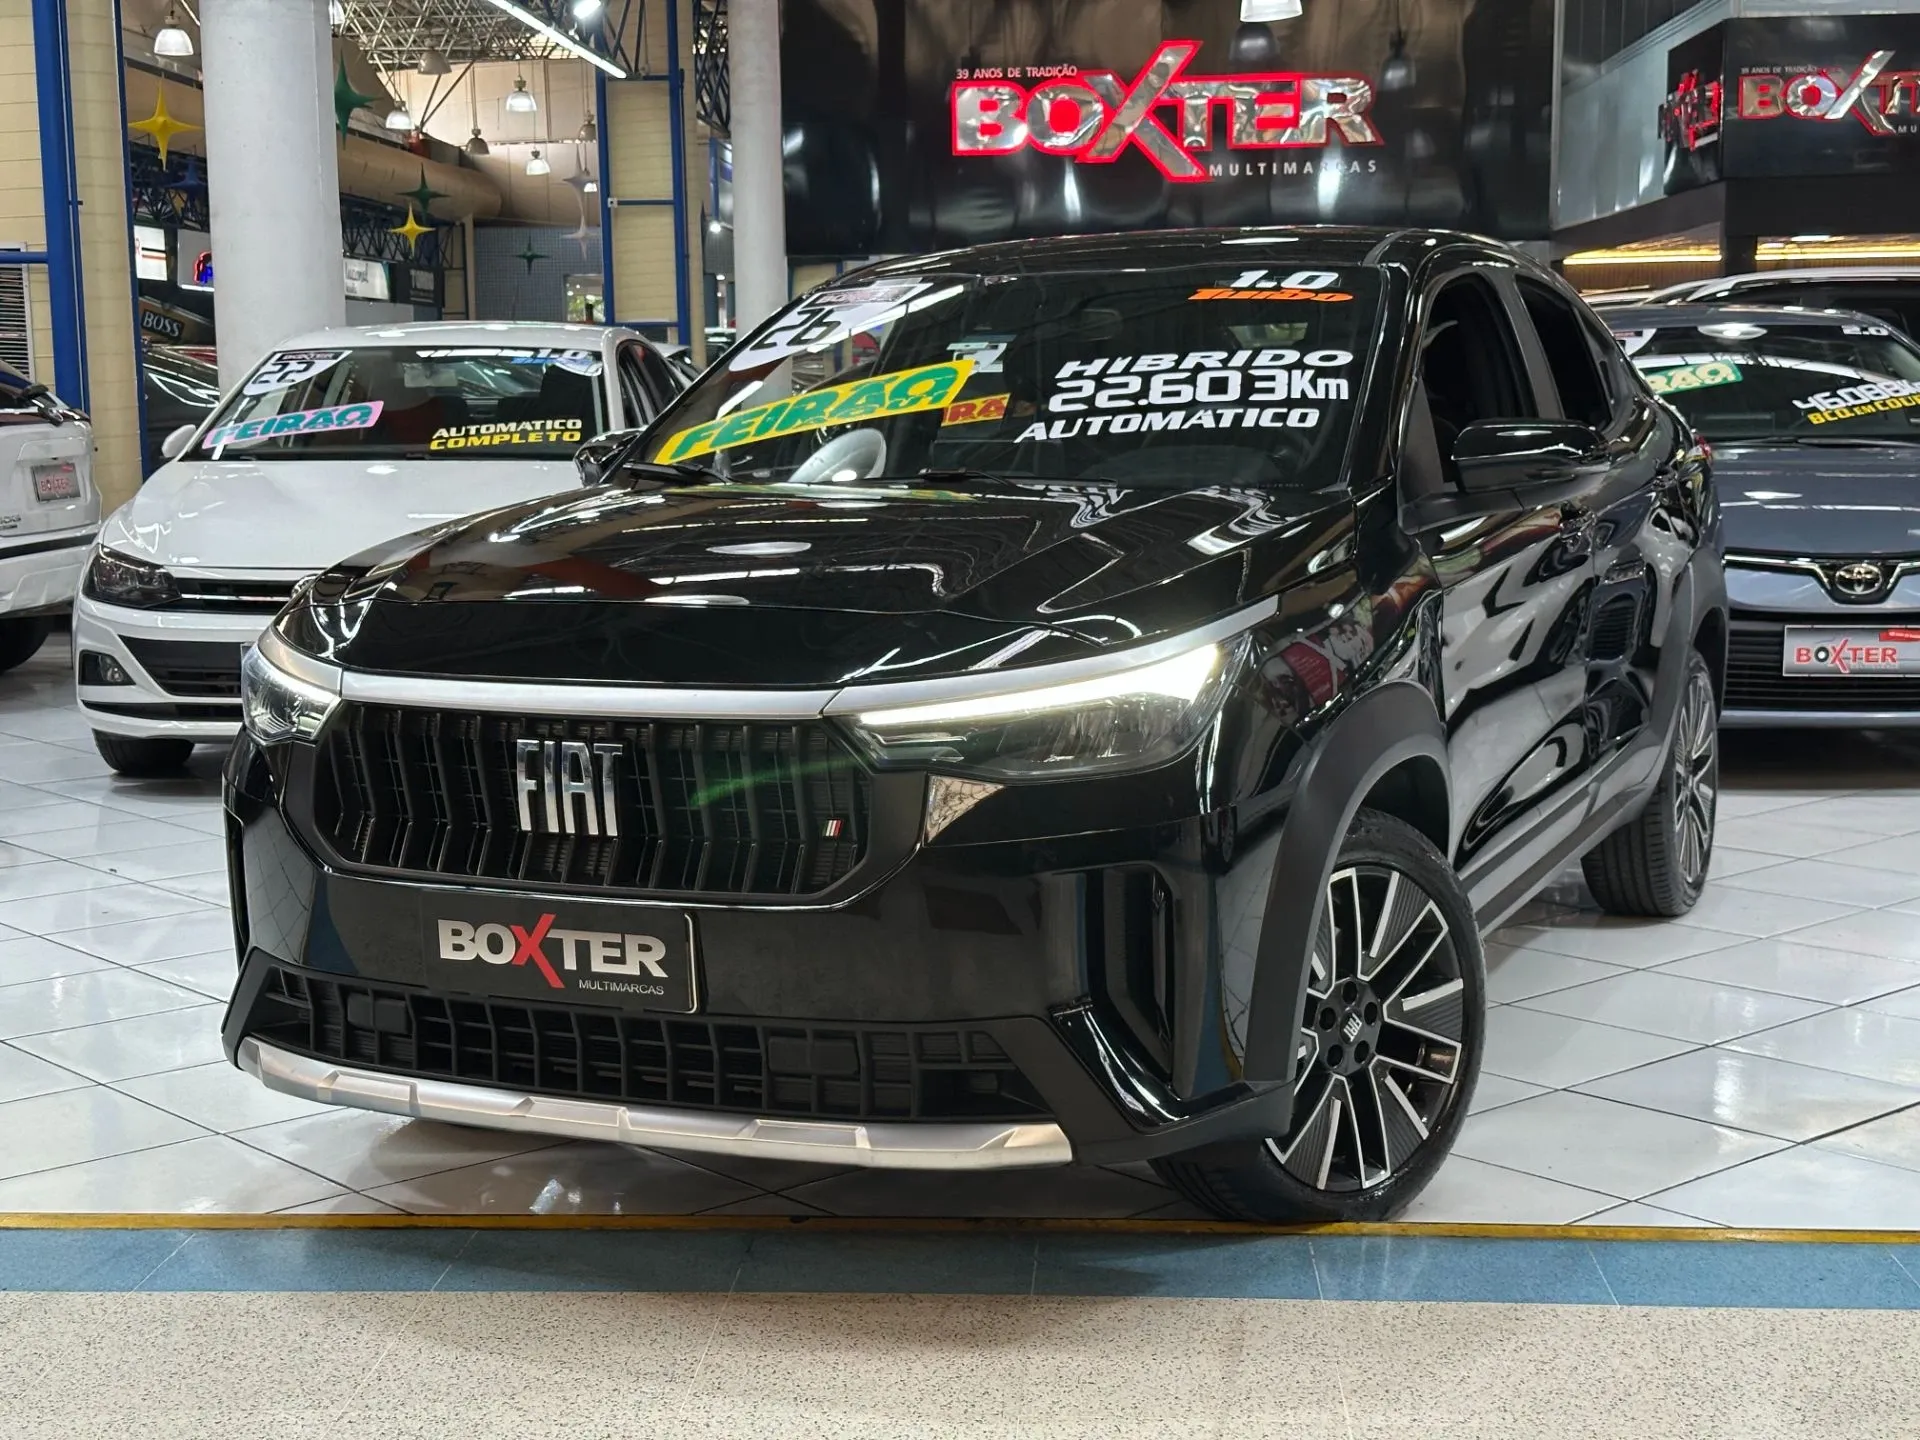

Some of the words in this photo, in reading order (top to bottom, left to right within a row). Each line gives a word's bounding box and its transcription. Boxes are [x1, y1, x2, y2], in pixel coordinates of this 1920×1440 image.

[956, 69, 968, 79] 39
[973, 67, 1003, 79] ANOS
[1007, 67, 1021, 78] DE
[1026, 63, 1077, 78] TRADIÇÃO
[1738, 49, 1920, 136] BOXT
[952, 40, 1384, 182] BOXTER
[1209, 159, 1377, 177] MULTIMARCAS
[1230, 269, 1340, 289] 1.0
[143, 311, 181, 337] BOSS
[1841, 324, 1890, 336] 2.0
[251, 361, 316, 385] 22
[429, 430, 582, 451] COMPLETO
[1794, 637, 1899, 674] BOXTER
[516, 738, 624, 837] FIAT
[437, 913, 669, 990] BOXTER
[578, 978, 665, 997] MULTIMARCAS
[1342, 1012, 1363, 1042] FIAT
